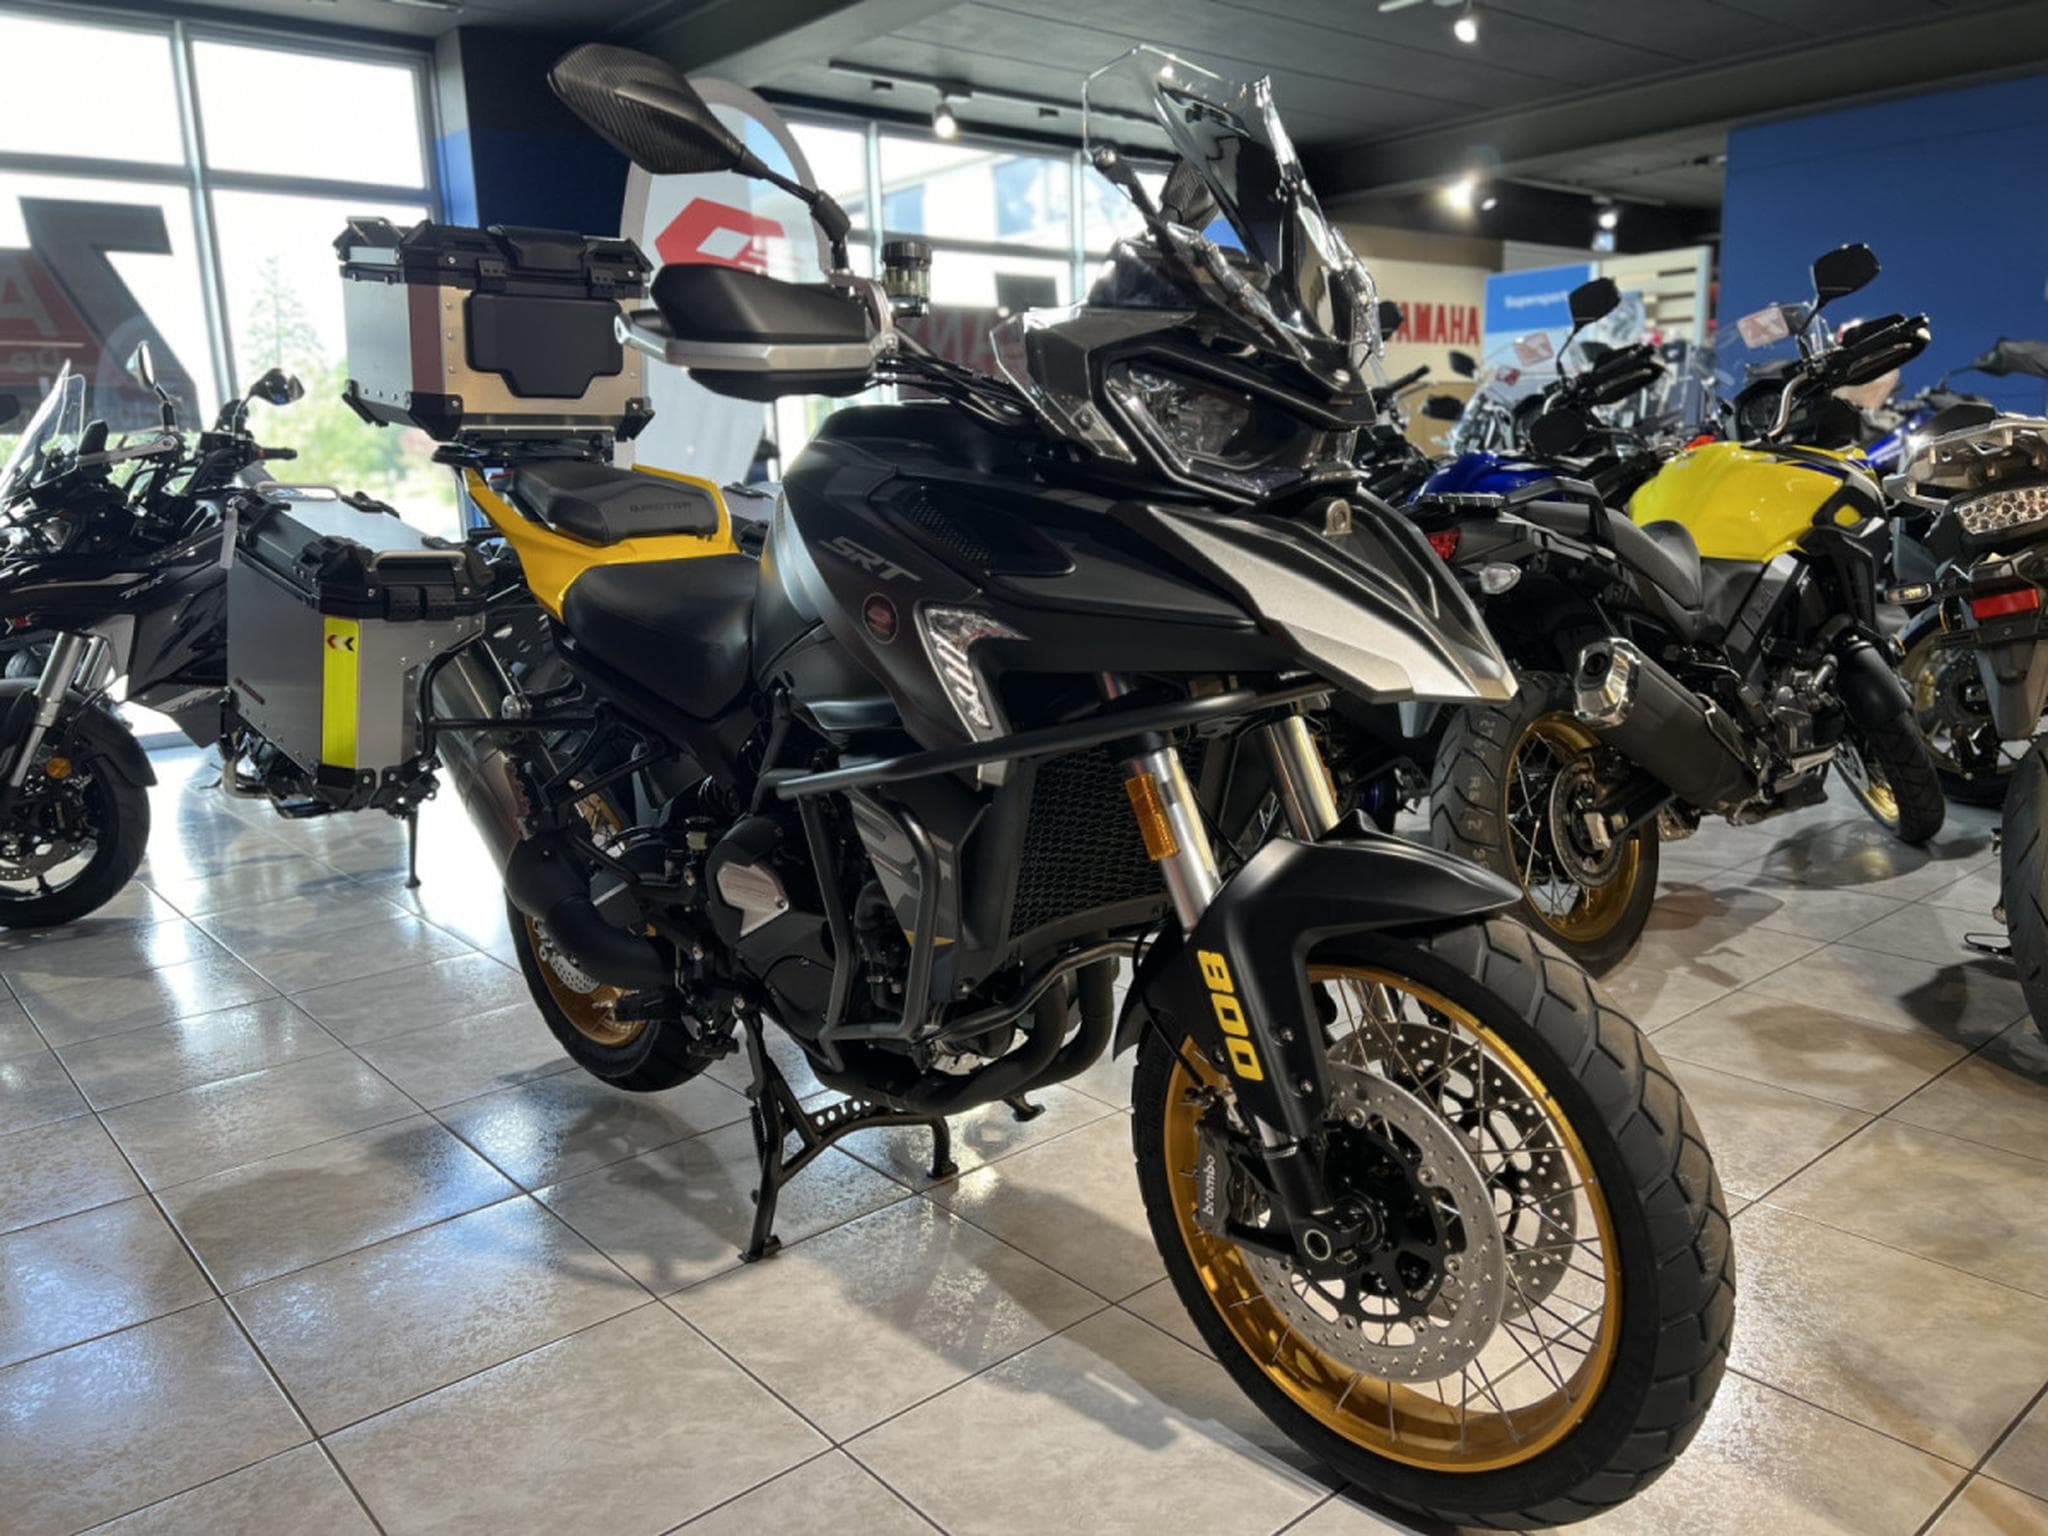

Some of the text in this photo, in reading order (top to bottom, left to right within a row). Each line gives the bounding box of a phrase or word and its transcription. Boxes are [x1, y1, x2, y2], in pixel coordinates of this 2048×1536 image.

[1388, 301, 1479, 345] AMAHA
[819, 536, 922, 580] SRT
[1198, 950, 1264, 1081] 800
[1203, 1153, 1217, 1216] brembo
